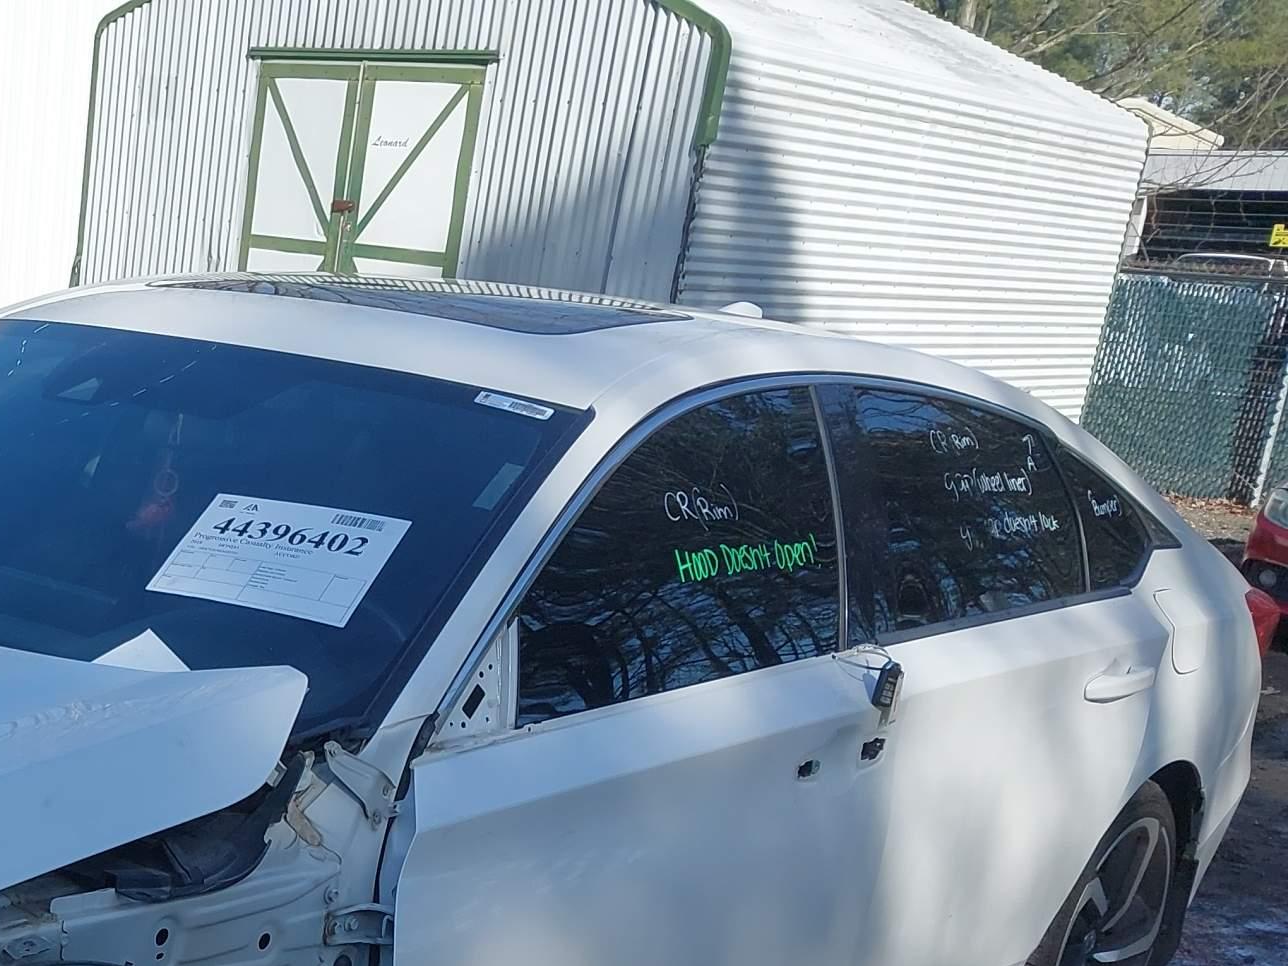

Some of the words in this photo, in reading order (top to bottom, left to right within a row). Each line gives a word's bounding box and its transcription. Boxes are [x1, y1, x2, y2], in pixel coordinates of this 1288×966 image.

[372, 136, 409, 148] Leonard
[193, 531, 239, 544] Progressive
[239, 538, 272, 550] Casualty
[274, 543, 314, 555] Insurance
[213, 517, 368, 556] 44396402
[675, 548, 719, 582] HOOD
[774, 533, 822, 572] Open!
